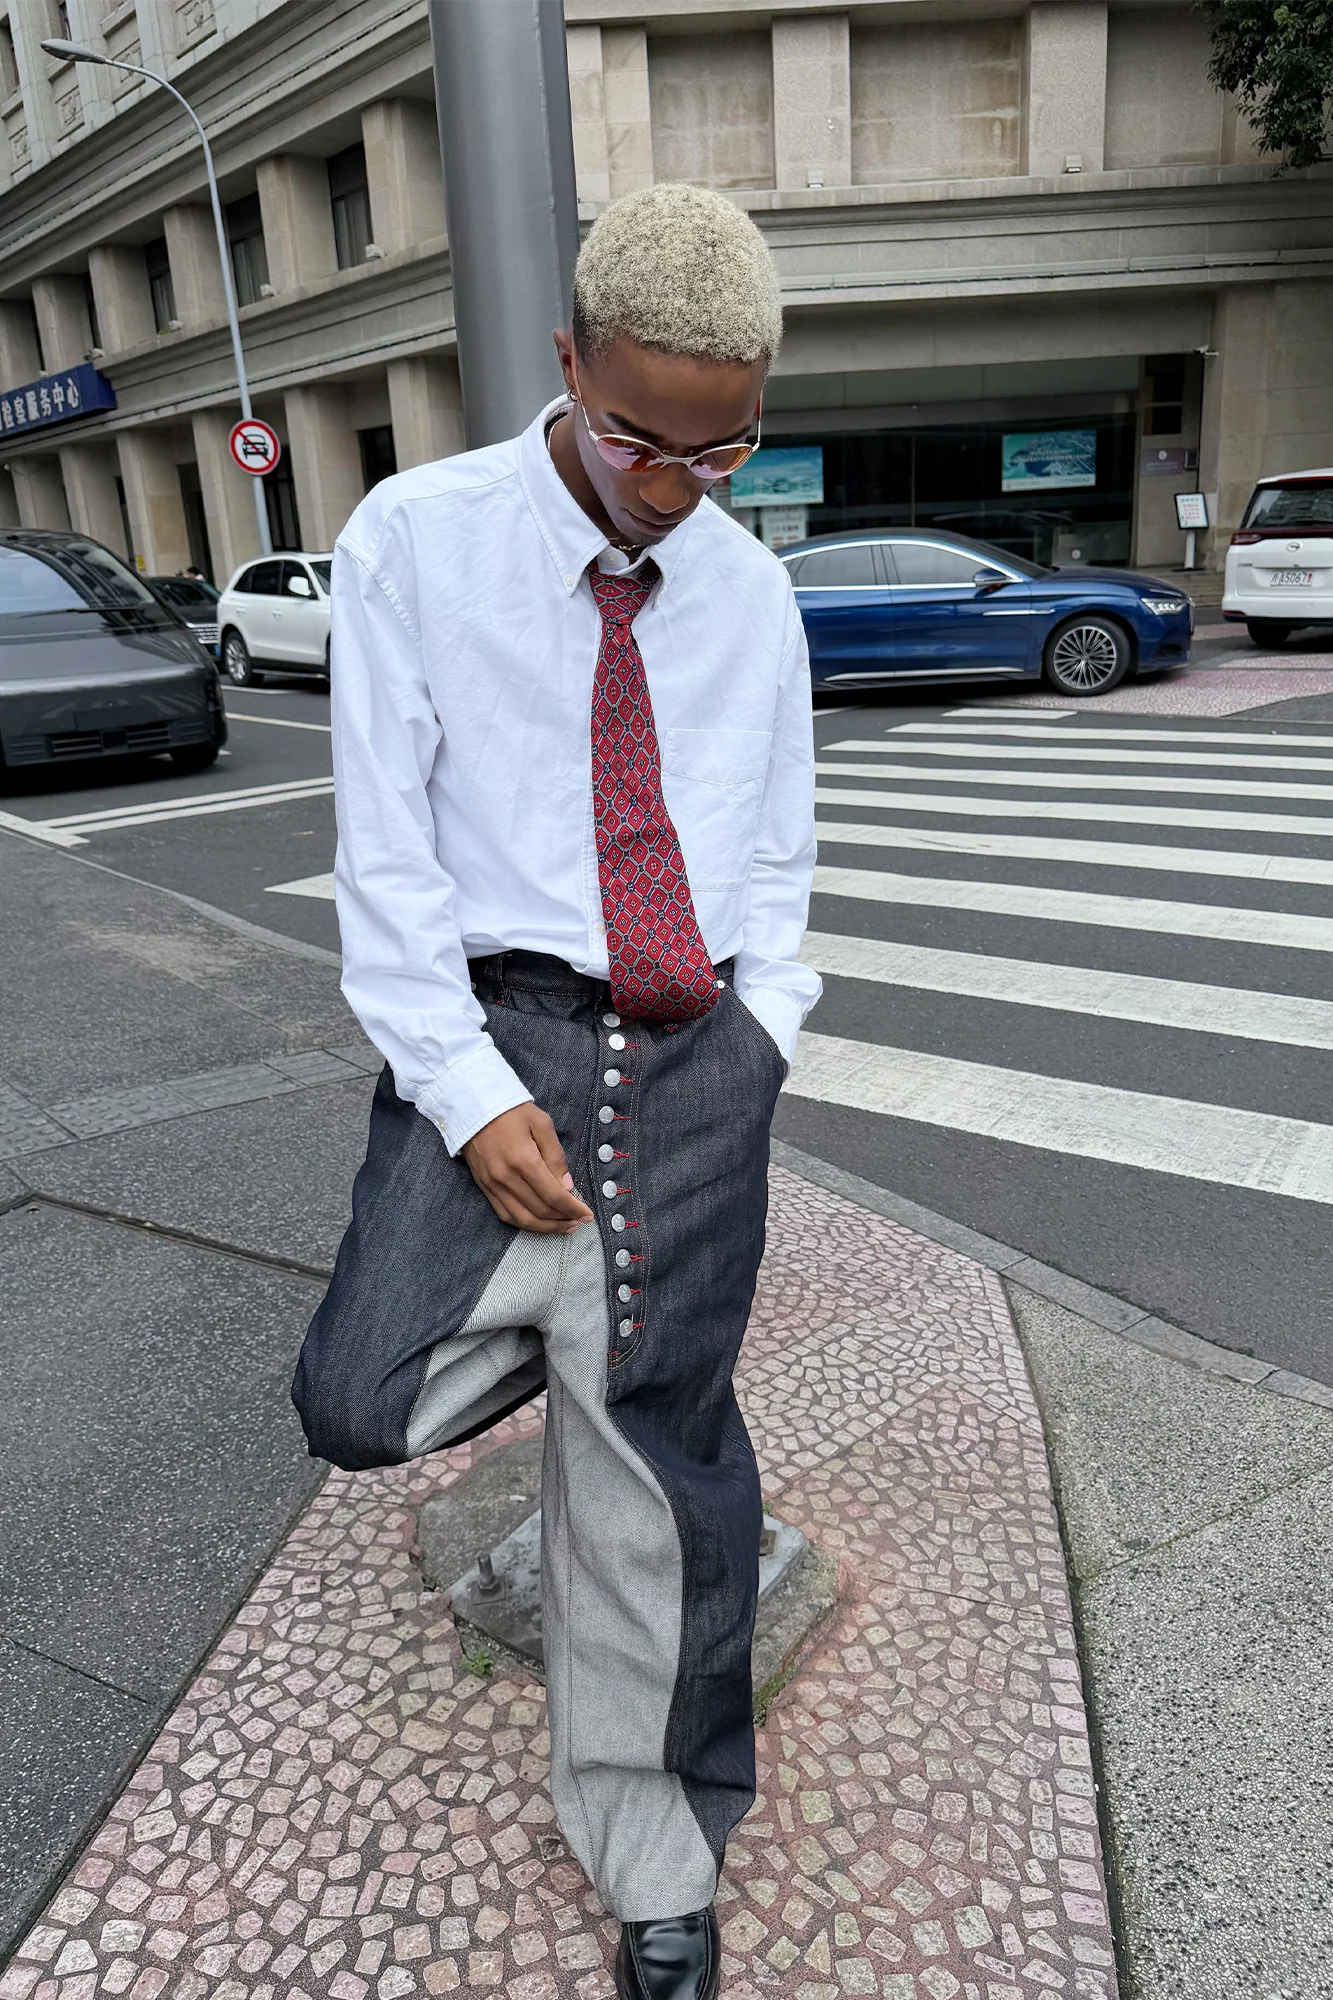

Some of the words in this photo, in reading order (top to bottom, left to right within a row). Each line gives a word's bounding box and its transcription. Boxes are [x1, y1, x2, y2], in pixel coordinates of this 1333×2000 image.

[0, 377, 79, 430] 检察服务中心
